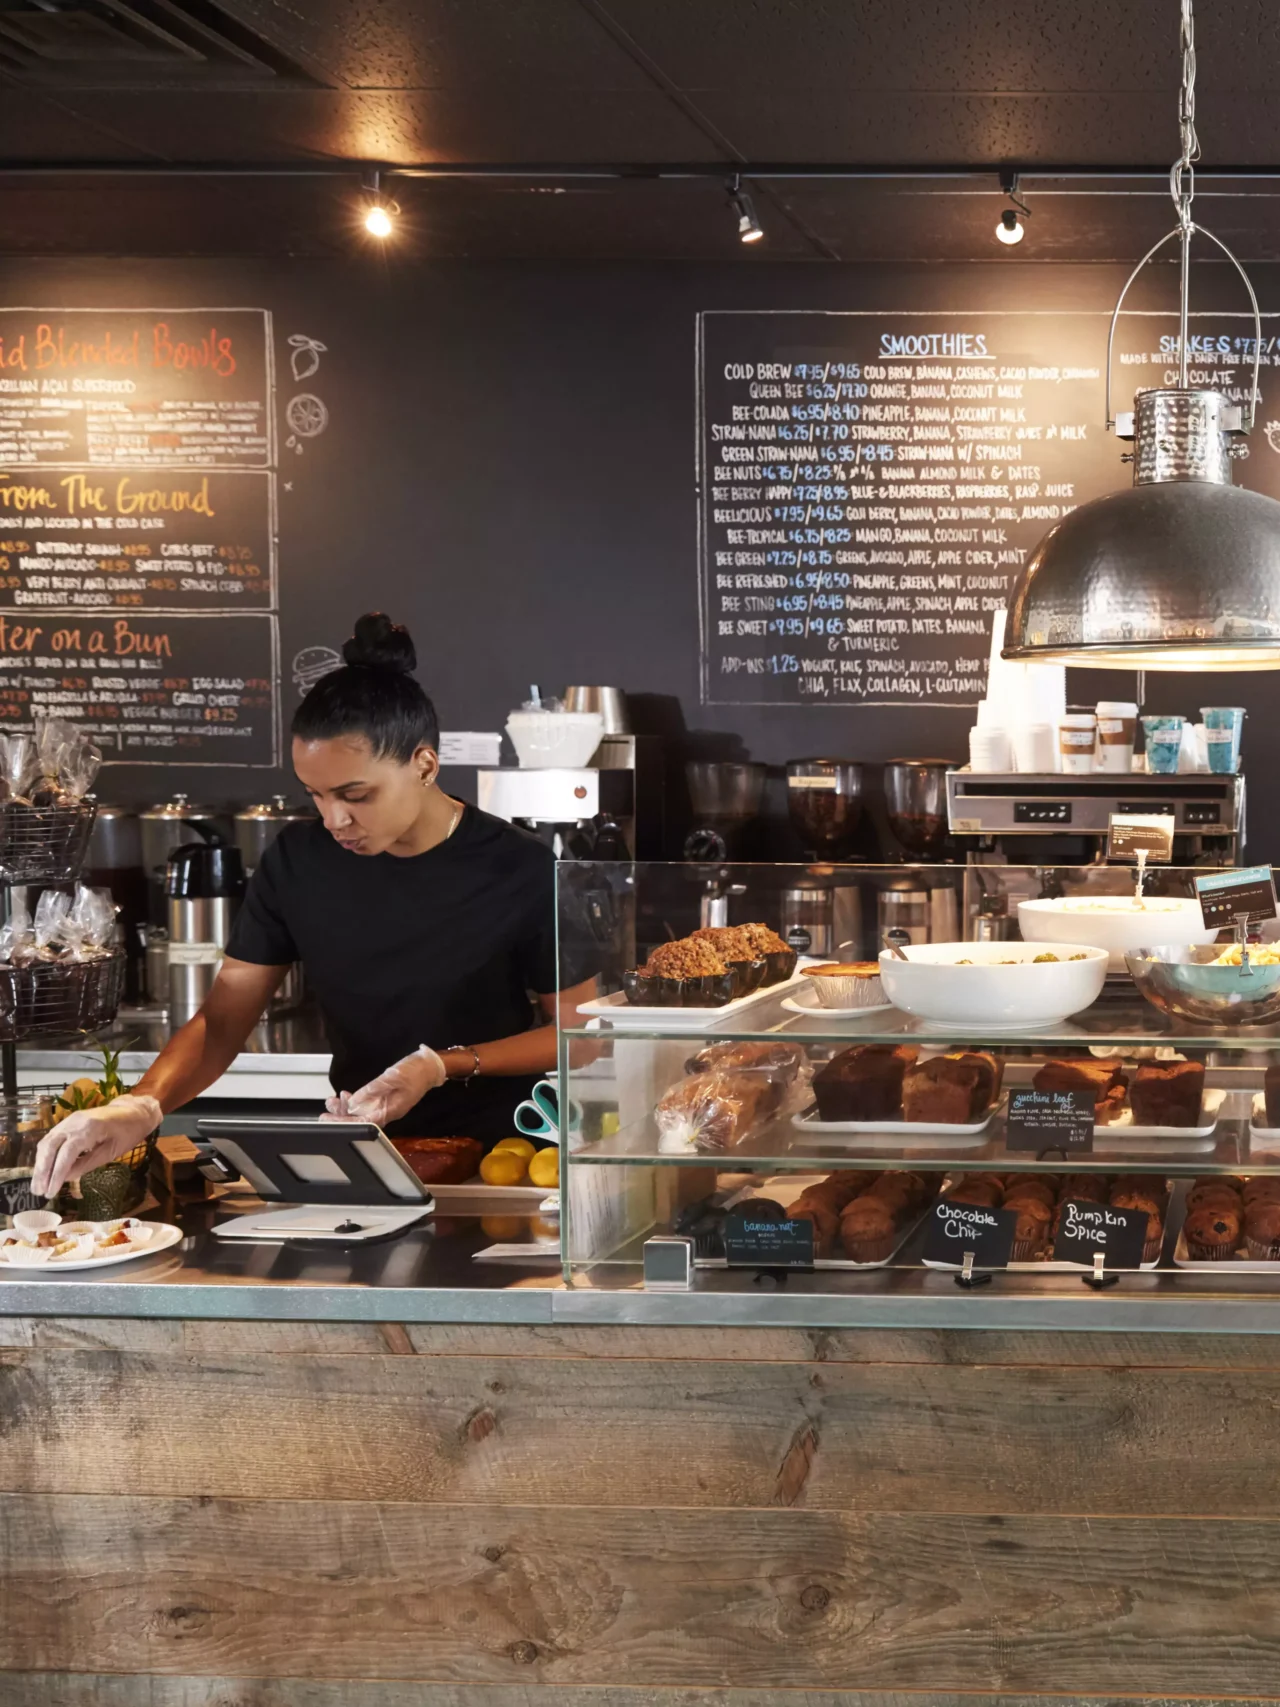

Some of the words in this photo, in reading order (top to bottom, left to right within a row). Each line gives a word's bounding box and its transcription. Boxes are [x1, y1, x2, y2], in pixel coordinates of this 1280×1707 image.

[35, 324, 139, 370] Blended
[153, 323, 236, 377] Bowls
[879, 334, 987, 356] SMOOTHIES
[725, 364, 754, 379] COLD
[758, 364, 791, 379] BREW
[749, 382, 781, 398] QUEEN
[785, 384, 803, 398] BEE
[722, 446, 754, 462] GREEN
[714, 467, 732, 480] BEE
[734, 466, 761, 480] NUTS
[1009, 467, 1041, 480] DATES
[61, 474, 107, 514] The
[117, 476, 215, 516] Ground
[732, 487, 761, 500] BERRY
[714, 507, 772, 522] BEELICIOUS
[998, 549, 1027, 564] MINT
[967, 576, 1008, 589] COCONUT
[722, 596, 740, 611] BEE
[745, 596, 774, 611] STING
[737, 620, 767, 635] SWEET
[51, 627, 81, 652] on
[88, 631, 108, 653] a
[115, 621, 172, 656] Bun
[842, 637, 899, 652] TURMERIC
[1013, 1092, 1050, 1108] zucchini
[1053, 1092, 1075, 1110] loaf
[937, 1204, 998, 1226] Chocolate
[1067, 1204, 1127, 1227] Pumpkin
[944, 1220, 982, 1239] Chip
[1064, 1220, 1107, 1243] Spice
